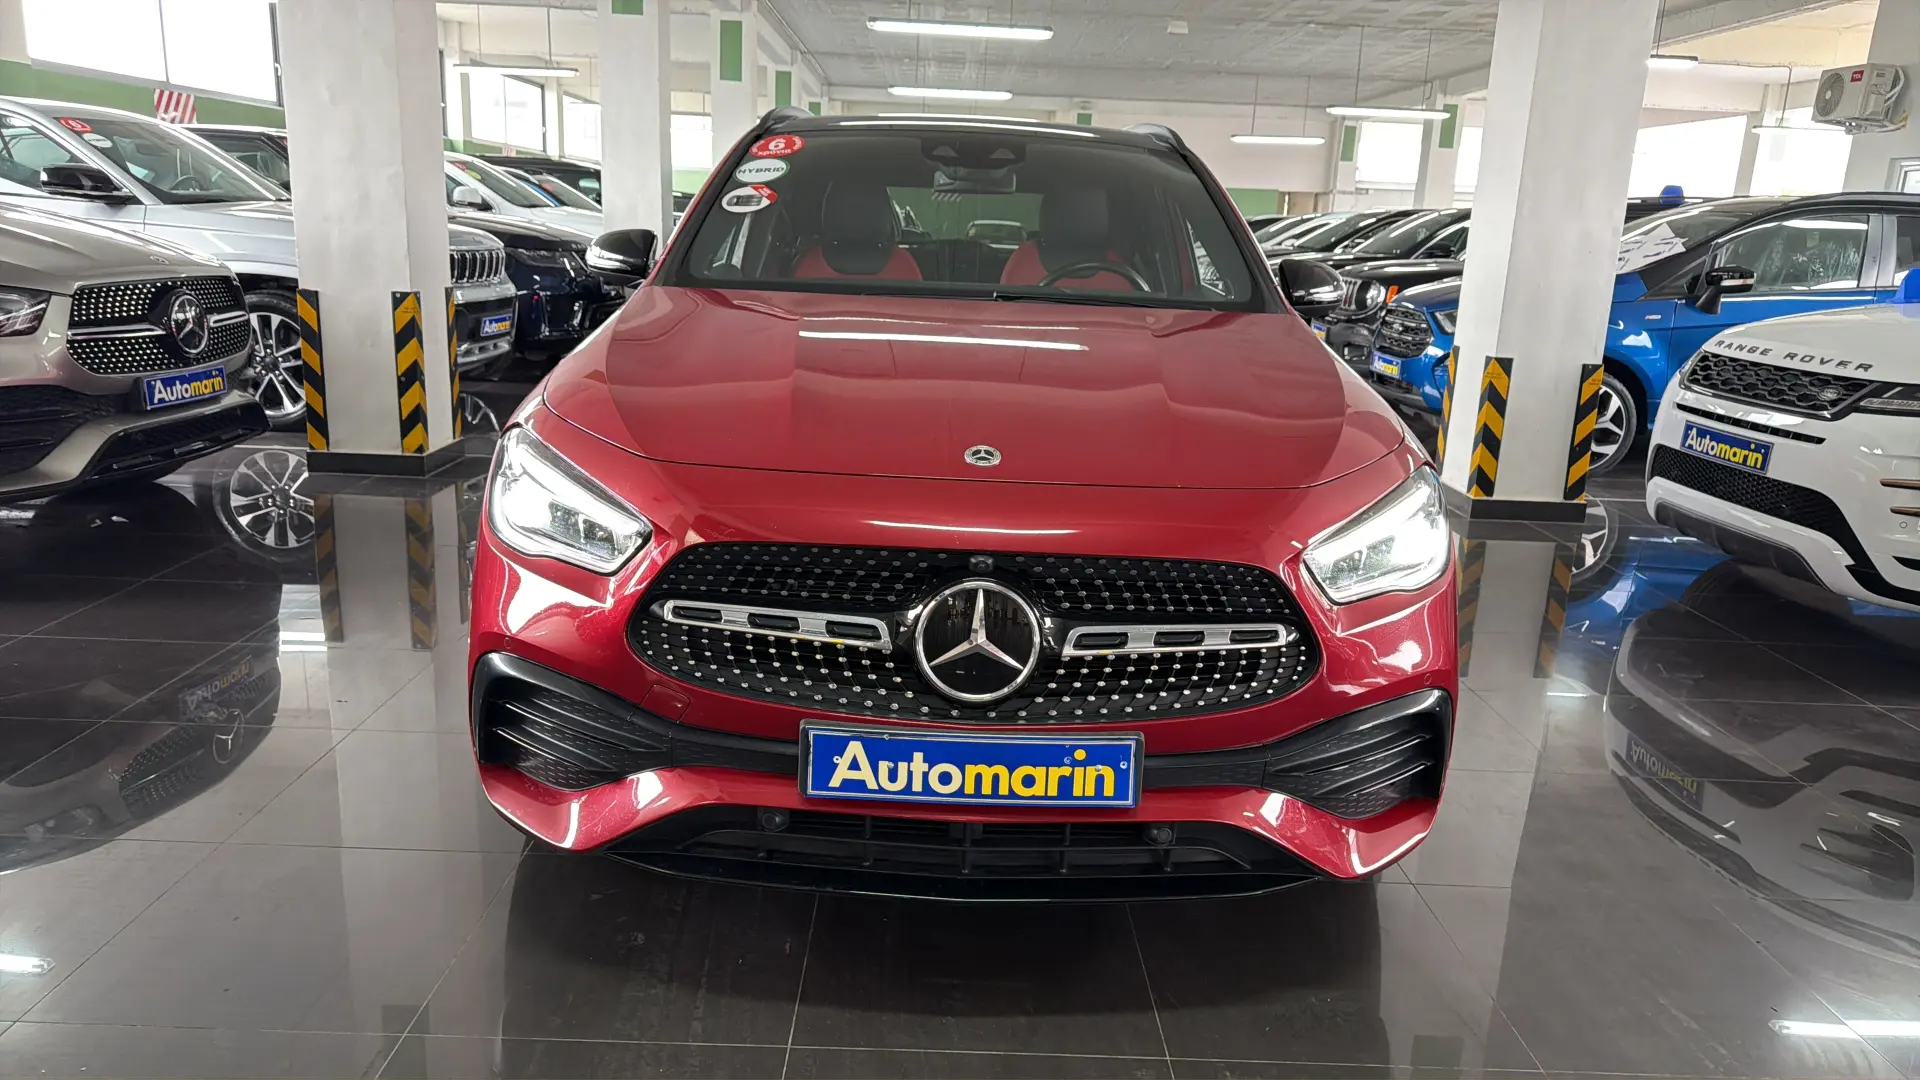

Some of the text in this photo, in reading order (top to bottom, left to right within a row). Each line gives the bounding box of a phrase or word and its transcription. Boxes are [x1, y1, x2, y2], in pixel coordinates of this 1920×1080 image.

[768, 138, 786, 151] 6
[737, 166, 785, 175] HYBRID
[1714, 340, 1875, 373] RANGE ROVER
[153, 370, 224, 404] Automarin
[1685, 427, 1763, 469] Automarin
[827, 740, 1116, 798] Automarin
